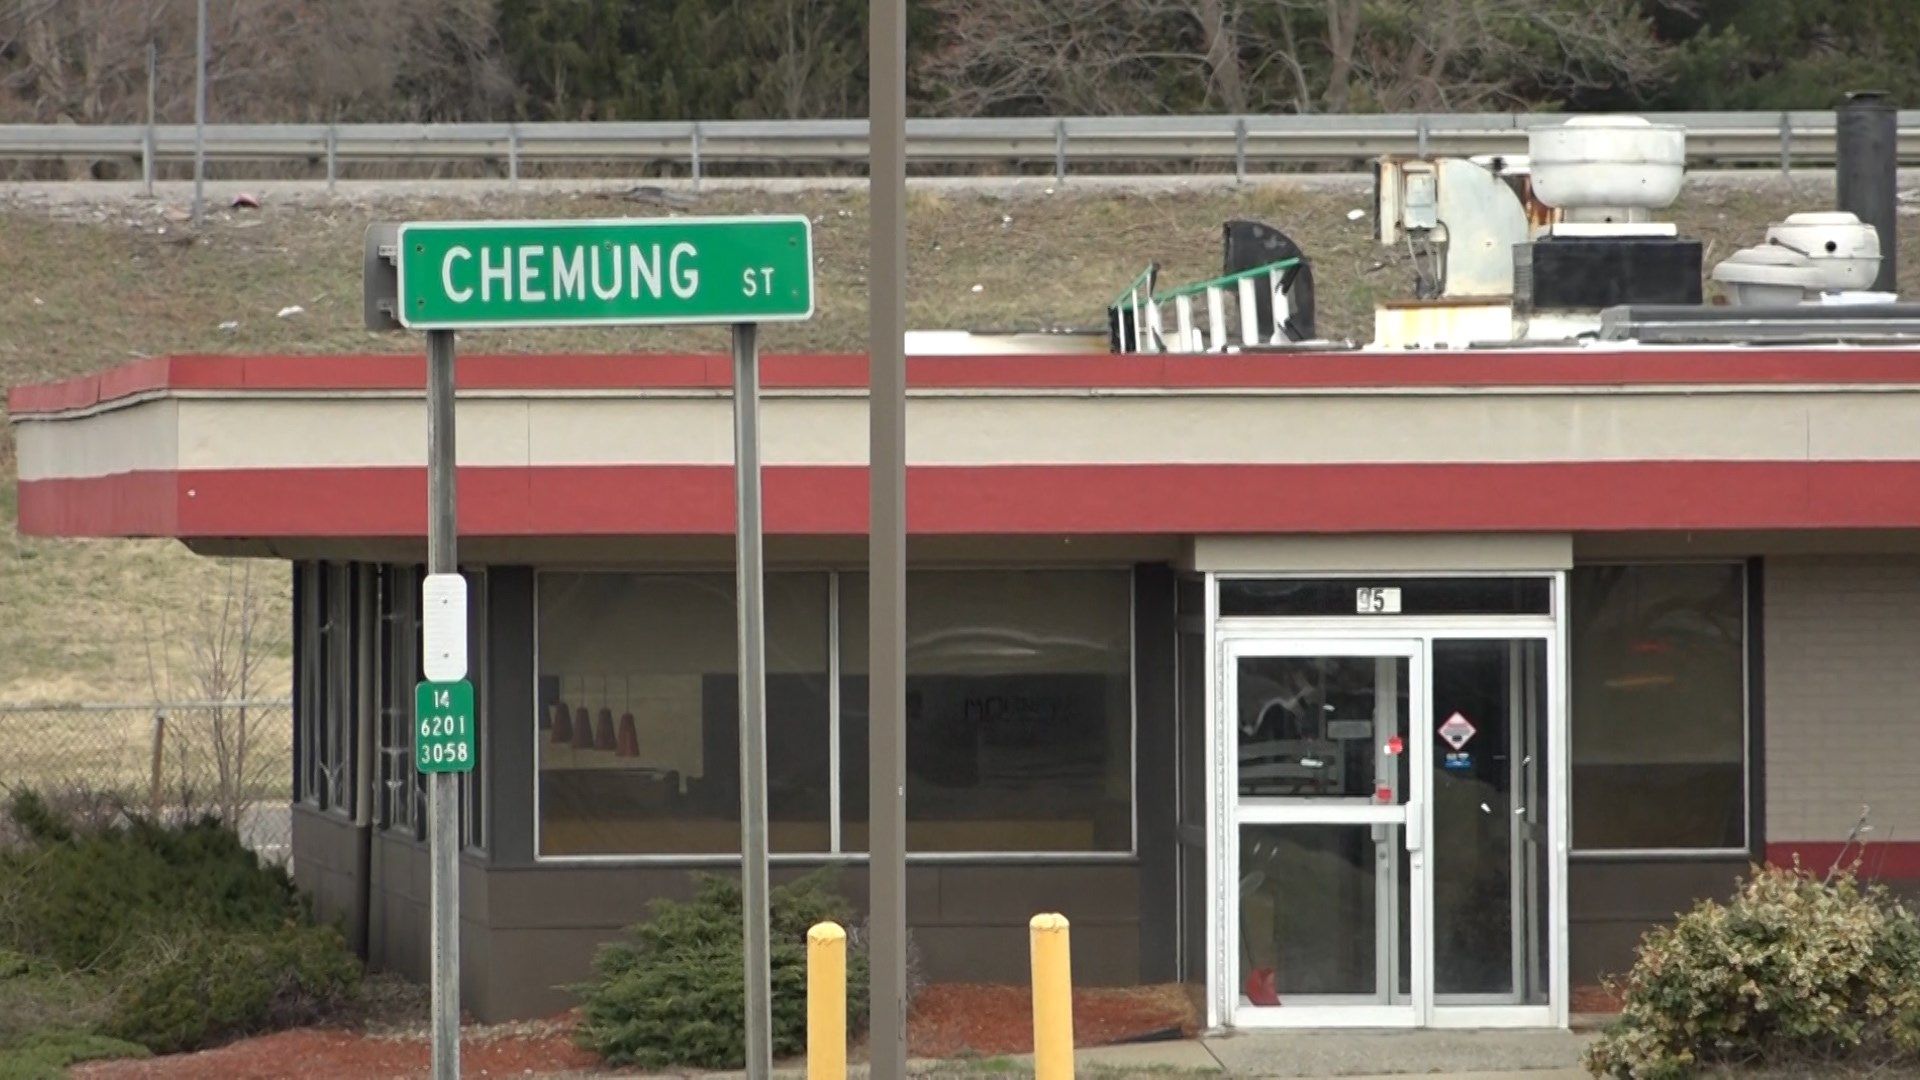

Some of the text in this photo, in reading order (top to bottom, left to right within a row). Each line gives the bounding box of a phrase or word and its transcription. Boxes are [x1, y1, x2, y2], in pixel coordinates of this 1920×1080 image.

[442, 242, 775, 302] CHEMUNG ST
[433, 689, 450, 708] 14
[421, 715, 465, 737] 6201
[421, 742, 468, 763] 3058
